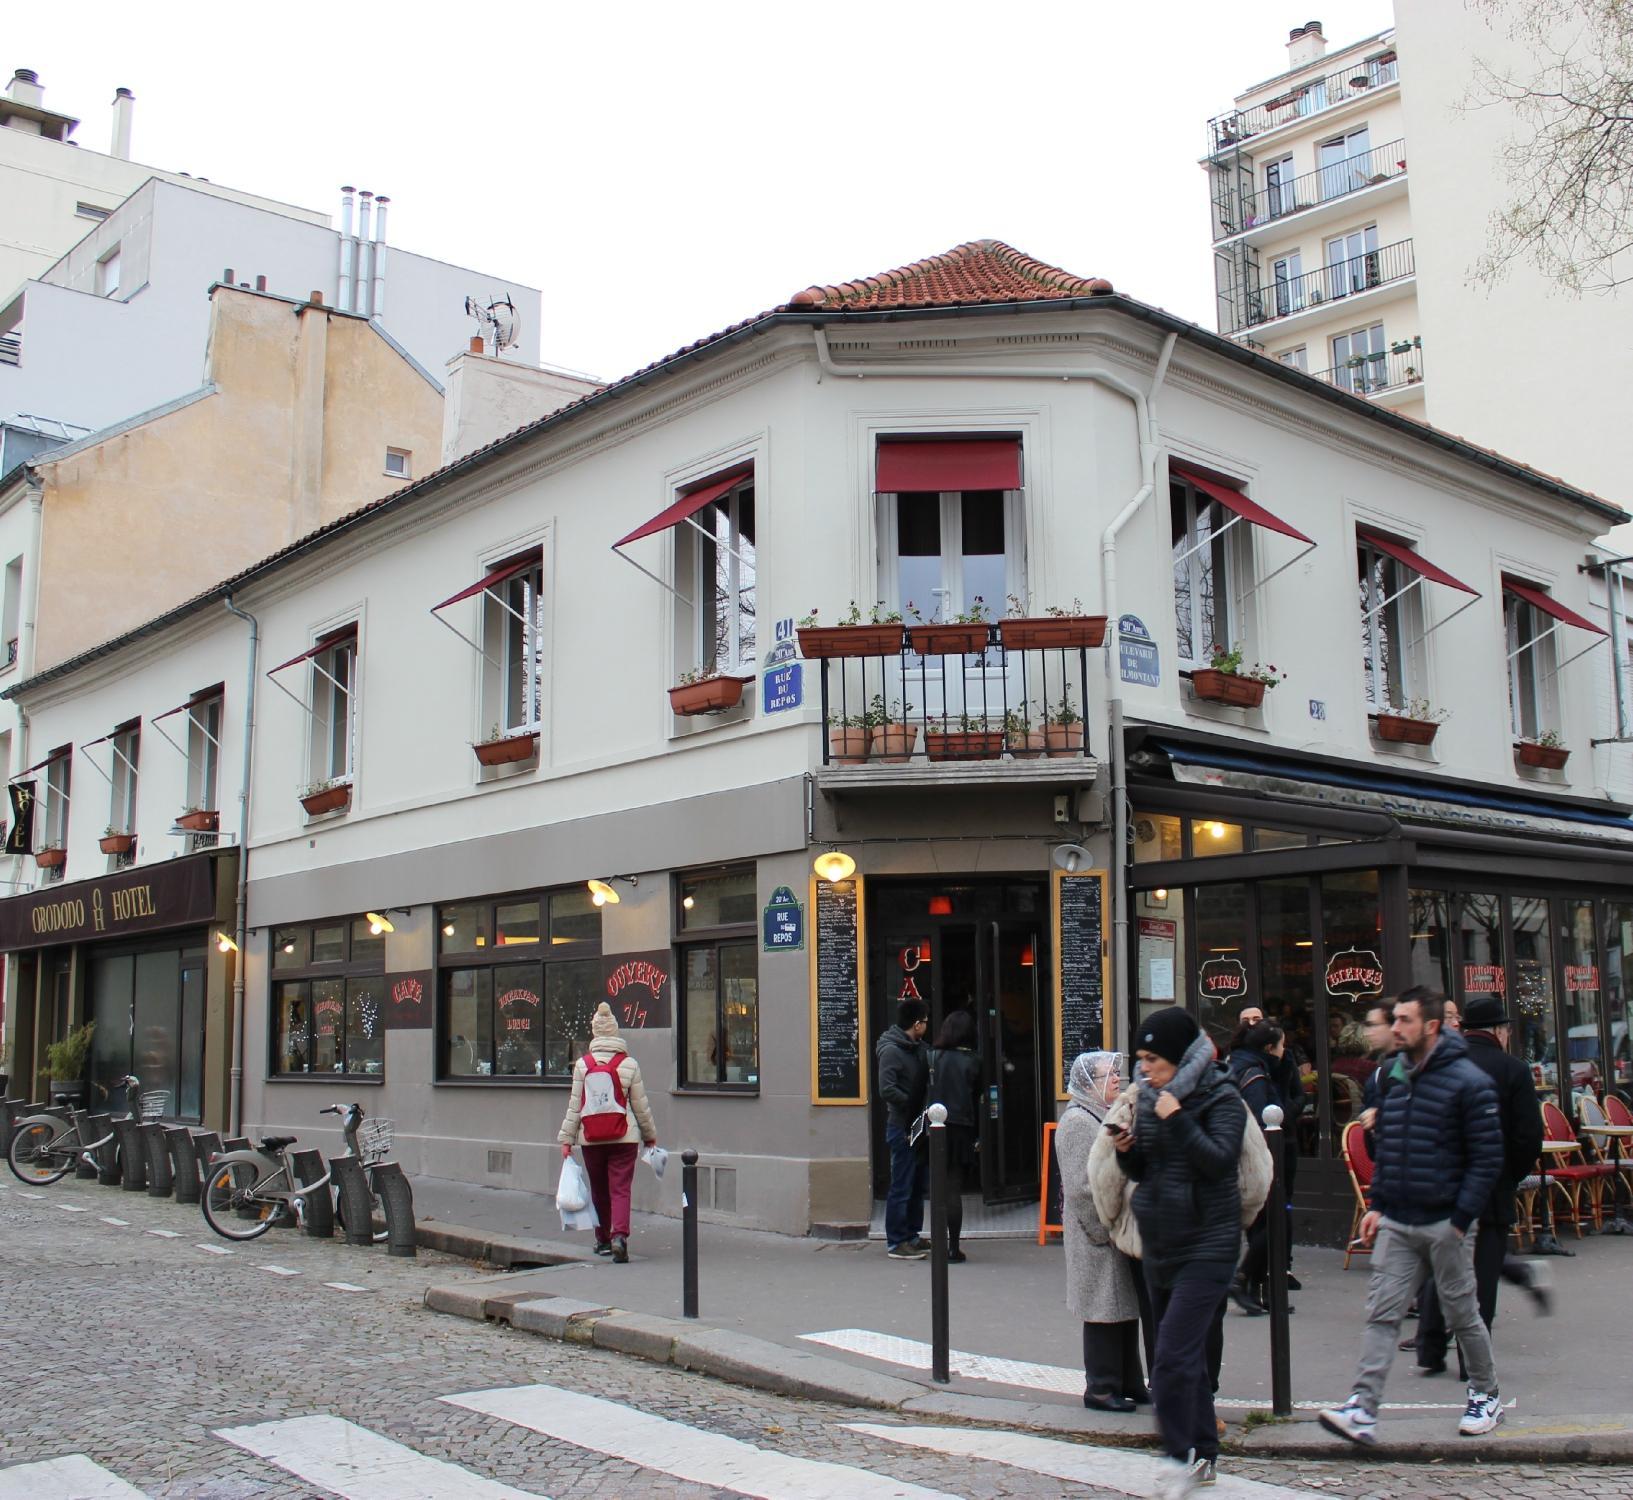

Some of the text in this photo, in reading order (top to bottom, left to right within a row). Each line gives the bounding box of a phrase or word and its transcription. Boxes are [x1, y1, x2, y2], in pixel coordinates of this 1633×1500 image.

[1120, 644, 1153, 660] ULEVARD
[1127, 658, 1138, 669] DE
[775, 671, 792, 685] RUE
[1120, 669, 1159, 686] ILMONTANT
[778, 684, 789, 695] DU
[770, 694, 796, 709] REPOS
[32, 899, 85, 933] OBODODO
[112, 885, 156, 921] HOTEL
[776, 912, 789, 921] RUE
[773, 933, 793, 943] REPOS
[608, 960, 668, 1000] OUVERT
[1207, 974, 1240, 990] VINS
[624, 1001, 647, 1029] 7/7
[506, 1018, 530, 1030] LUNCH
